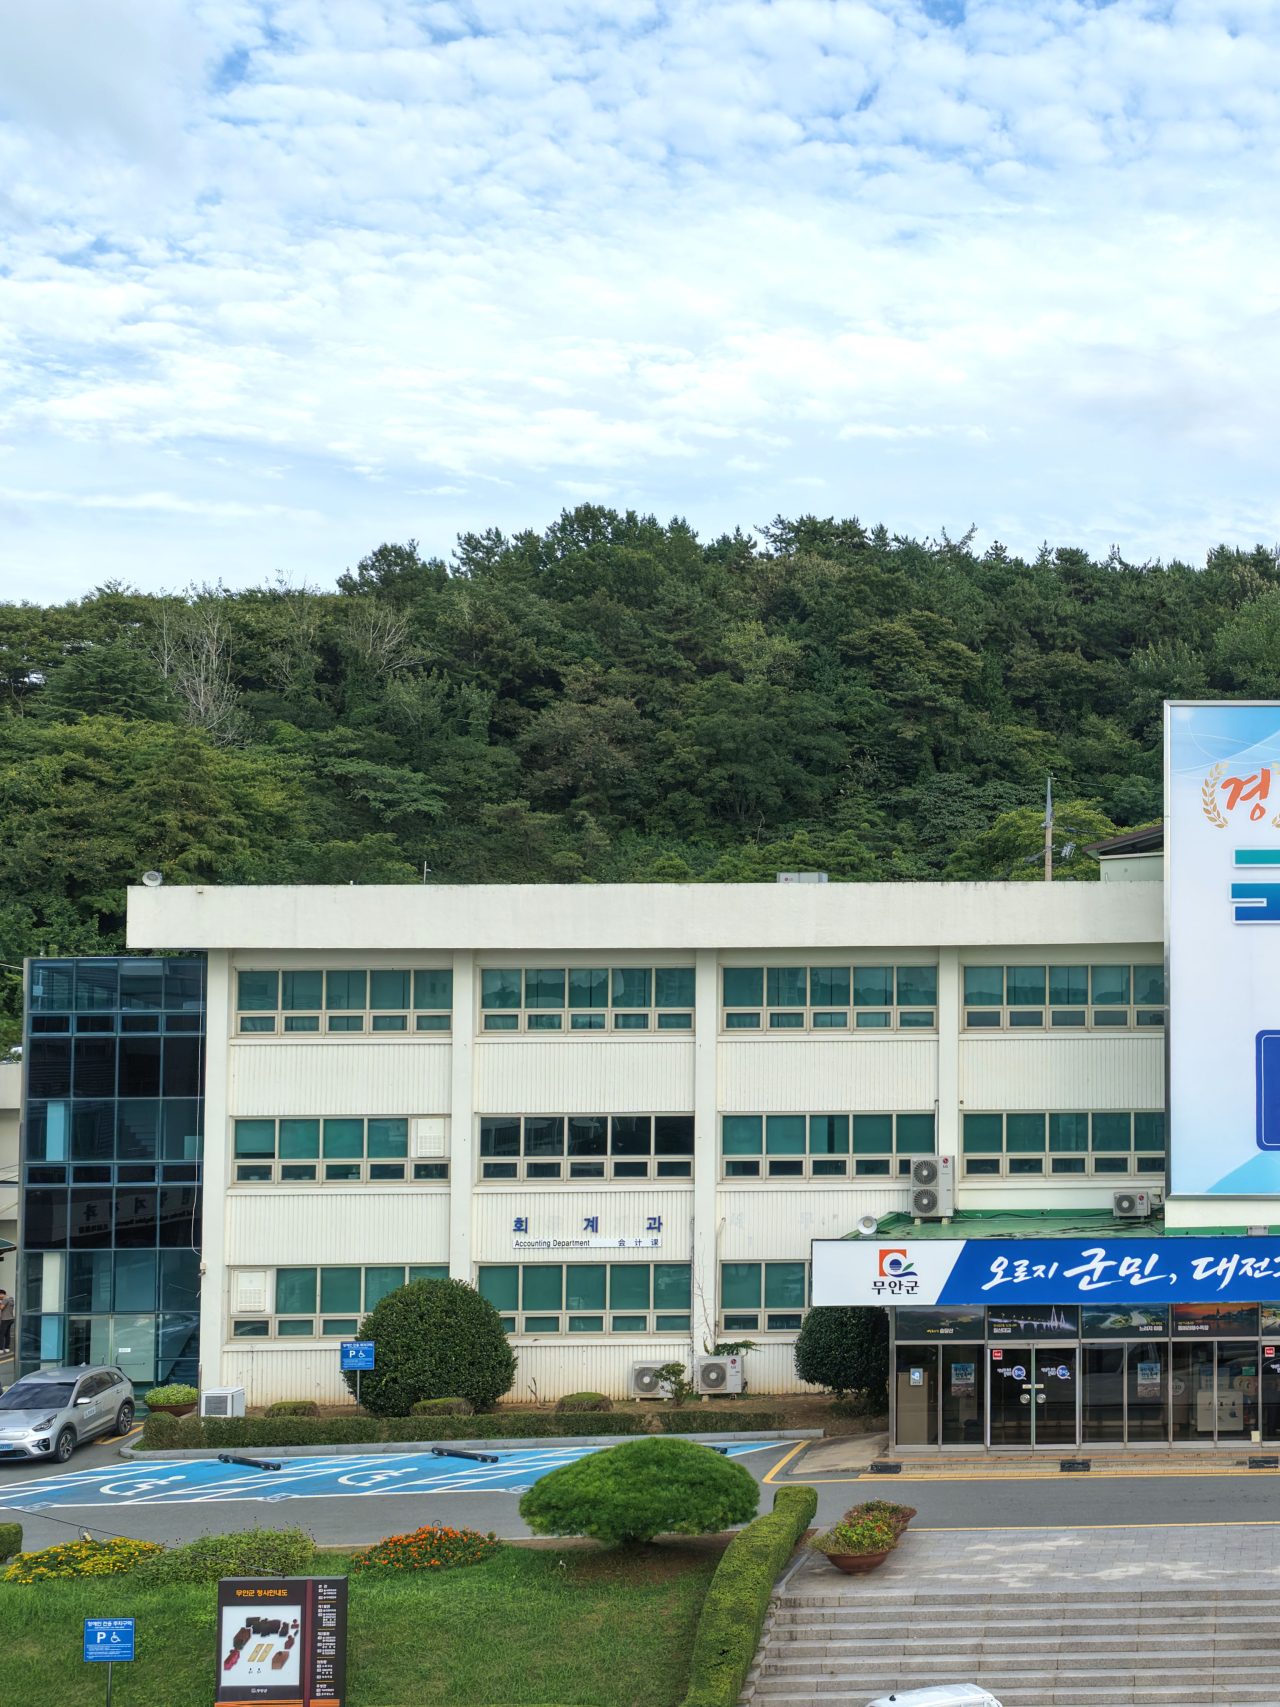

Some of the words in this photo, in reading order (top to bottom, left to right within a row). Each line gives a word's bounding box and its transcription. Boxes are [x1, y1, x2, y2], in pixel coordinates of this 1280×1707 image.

[1221, 769, 1270, 822] 경
[514, 1239, 551, 1248] Accounting
[552, 1239, 590, 1248] Department
[981, 1256, 1058, 1291] 오로지
[1063, 1247, 1177, 1291] 군민,
[871, 1280, 920, 1295] 무안군
[96, 1631, 106, 1643] P
